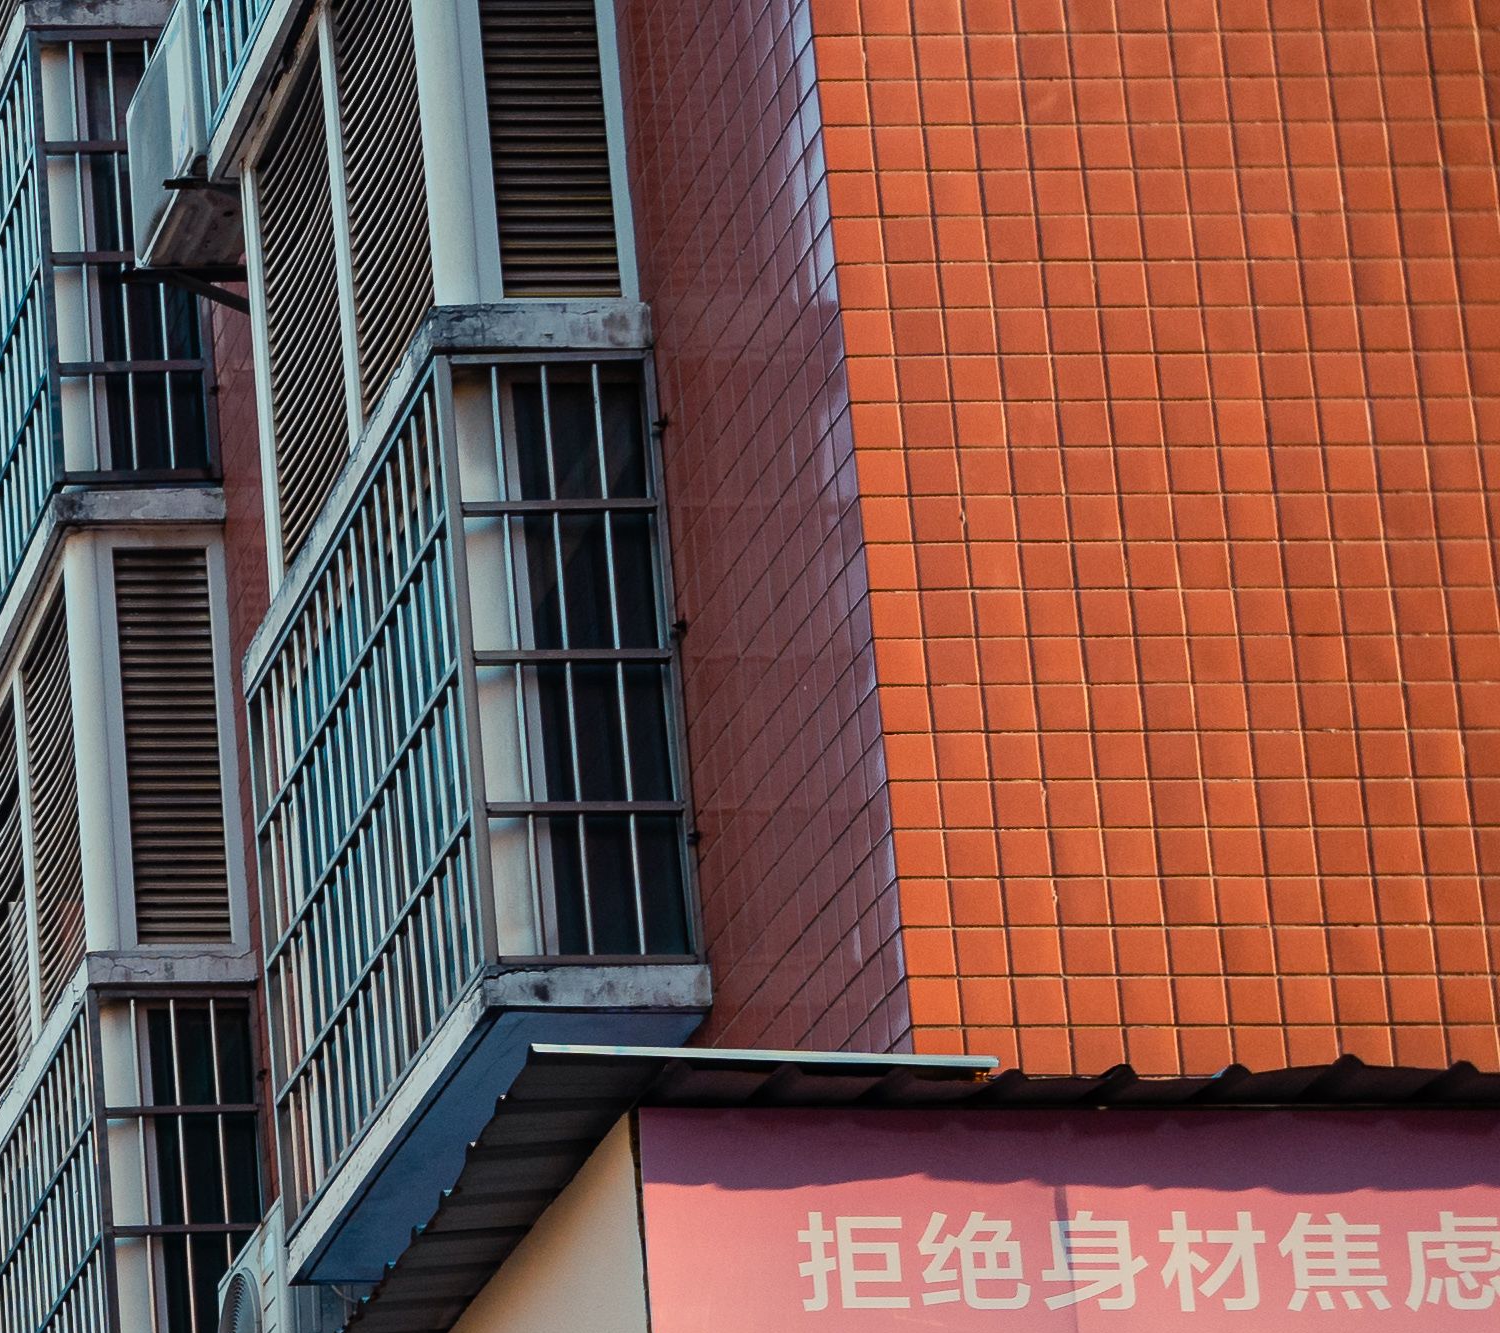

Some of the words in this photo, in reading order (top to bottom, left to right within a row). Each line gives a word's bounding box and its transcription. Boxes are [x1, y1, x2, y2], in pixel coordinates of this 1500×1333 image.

[797, 1211, 1500, 1313] 拒绝身材焦虑
